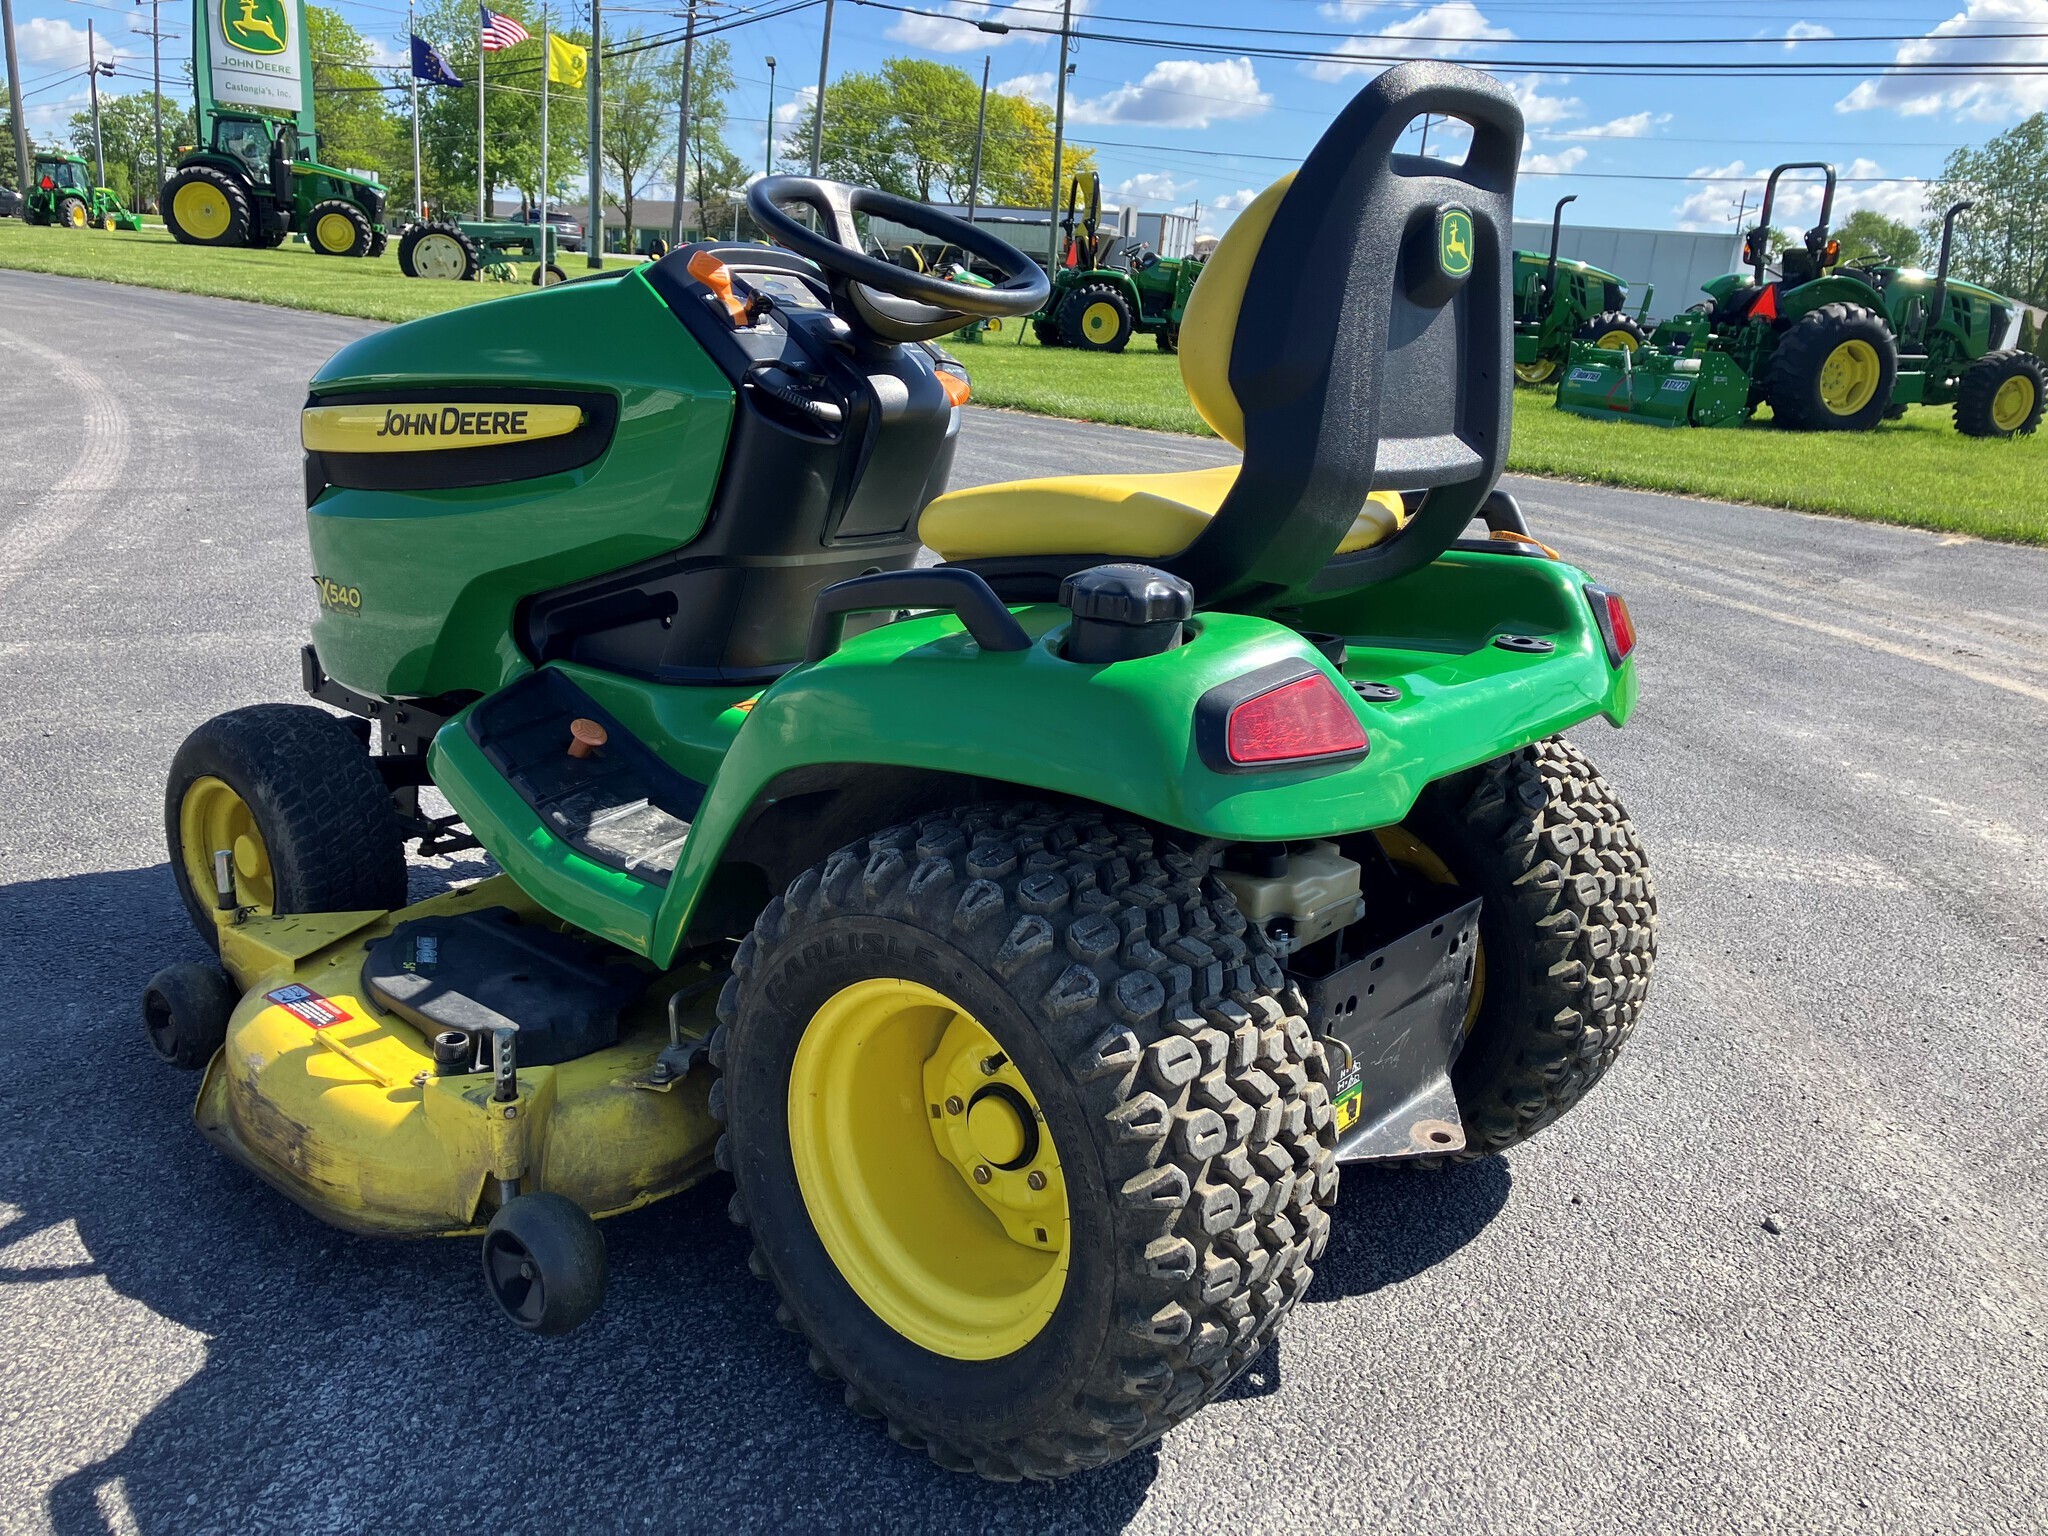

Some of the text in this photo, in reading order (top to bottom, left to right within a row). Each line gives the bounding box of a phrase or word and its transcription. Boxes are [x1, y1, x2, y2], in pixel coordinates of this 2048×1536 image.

[221, 56, 291, 74] JOHN DEERE
[225, 81, 292, 98] Castongia's, Inc.
[377, 407, 528, 437] JOHN DEERE
[312, 577, 361, 608] X540
[764, 932, 939, 1006] CARLISLE
